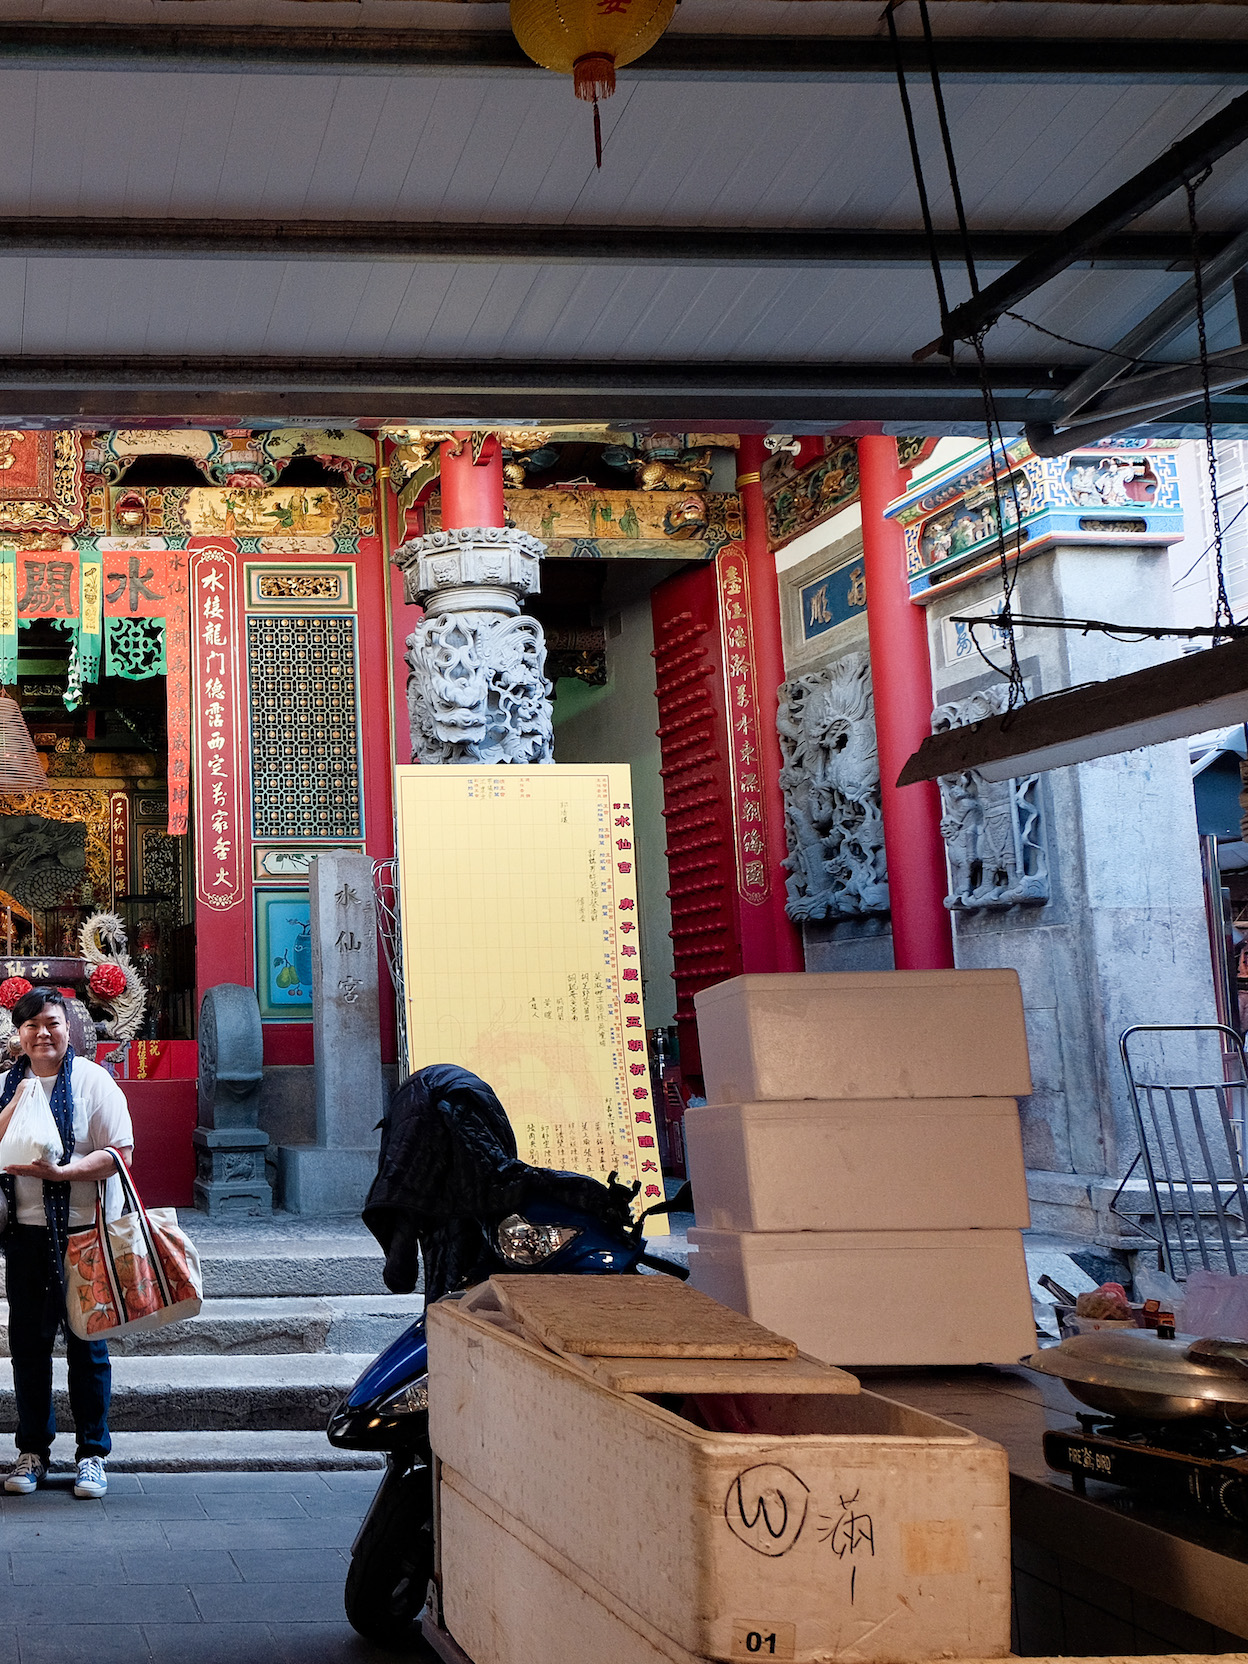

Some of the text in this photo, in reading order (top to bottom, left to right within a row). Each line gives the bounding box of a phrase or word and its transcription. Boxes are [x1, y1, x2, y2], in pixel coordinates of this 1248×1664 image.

[614, 815, 632, 874] 水仙宮
[335, 883, 363, 1003] 水仙宮
[1068, 1447, 1111, 1470] FIRE BIRD
[746, 1632, 777, 1653] 01
